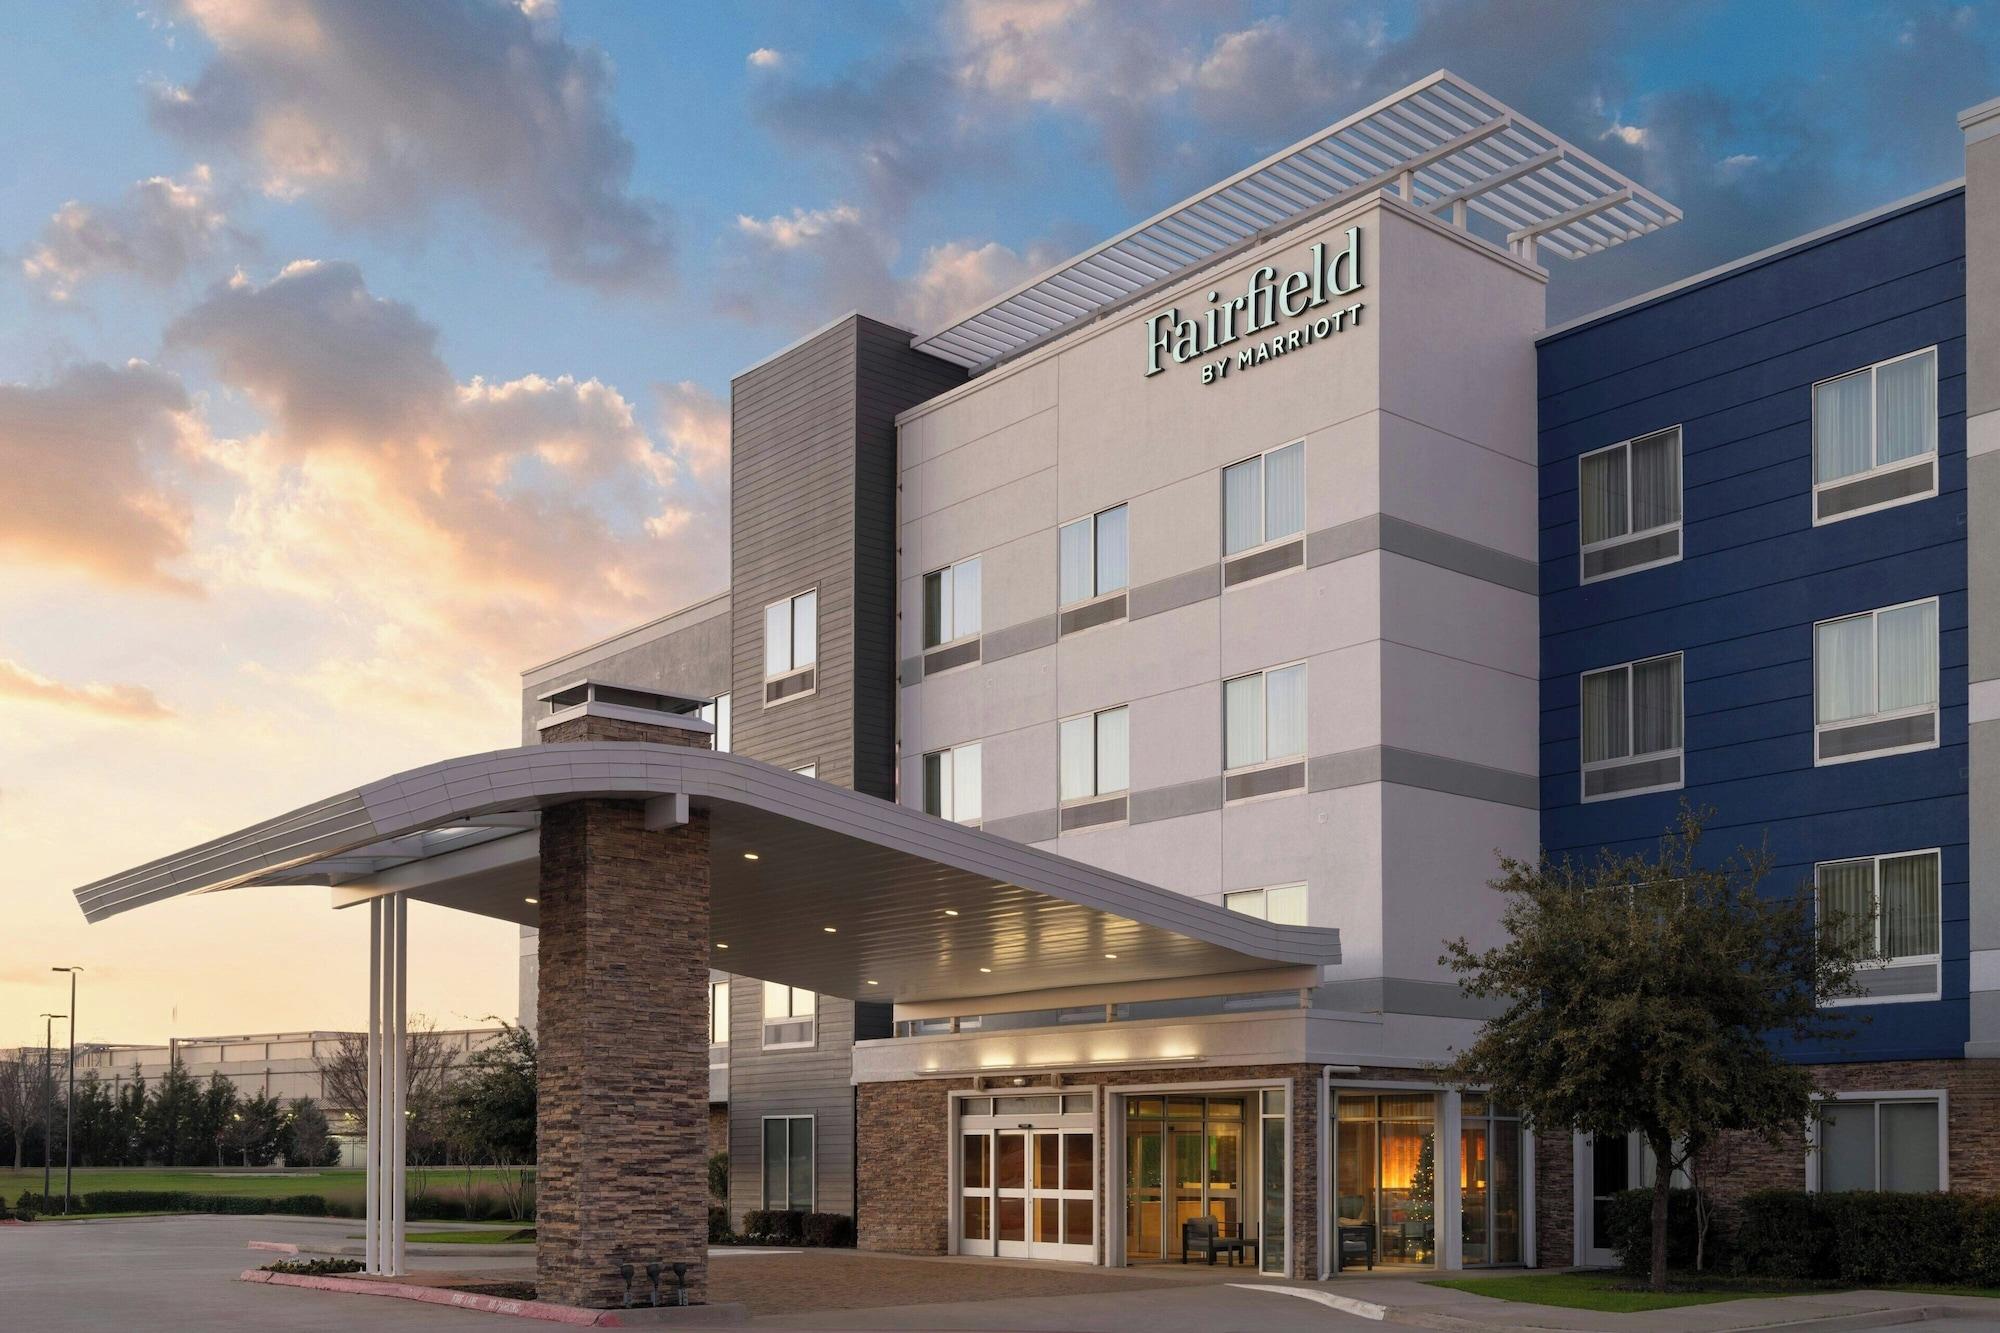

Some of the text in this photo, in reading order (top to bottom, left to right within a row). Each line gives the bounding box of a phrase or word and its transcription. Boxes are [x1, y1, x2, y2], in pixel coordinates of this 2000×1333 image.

[1144, 226, 1364, 378] Fairfield
[1201, 303, 1364, 385] BY MARRIOTT
